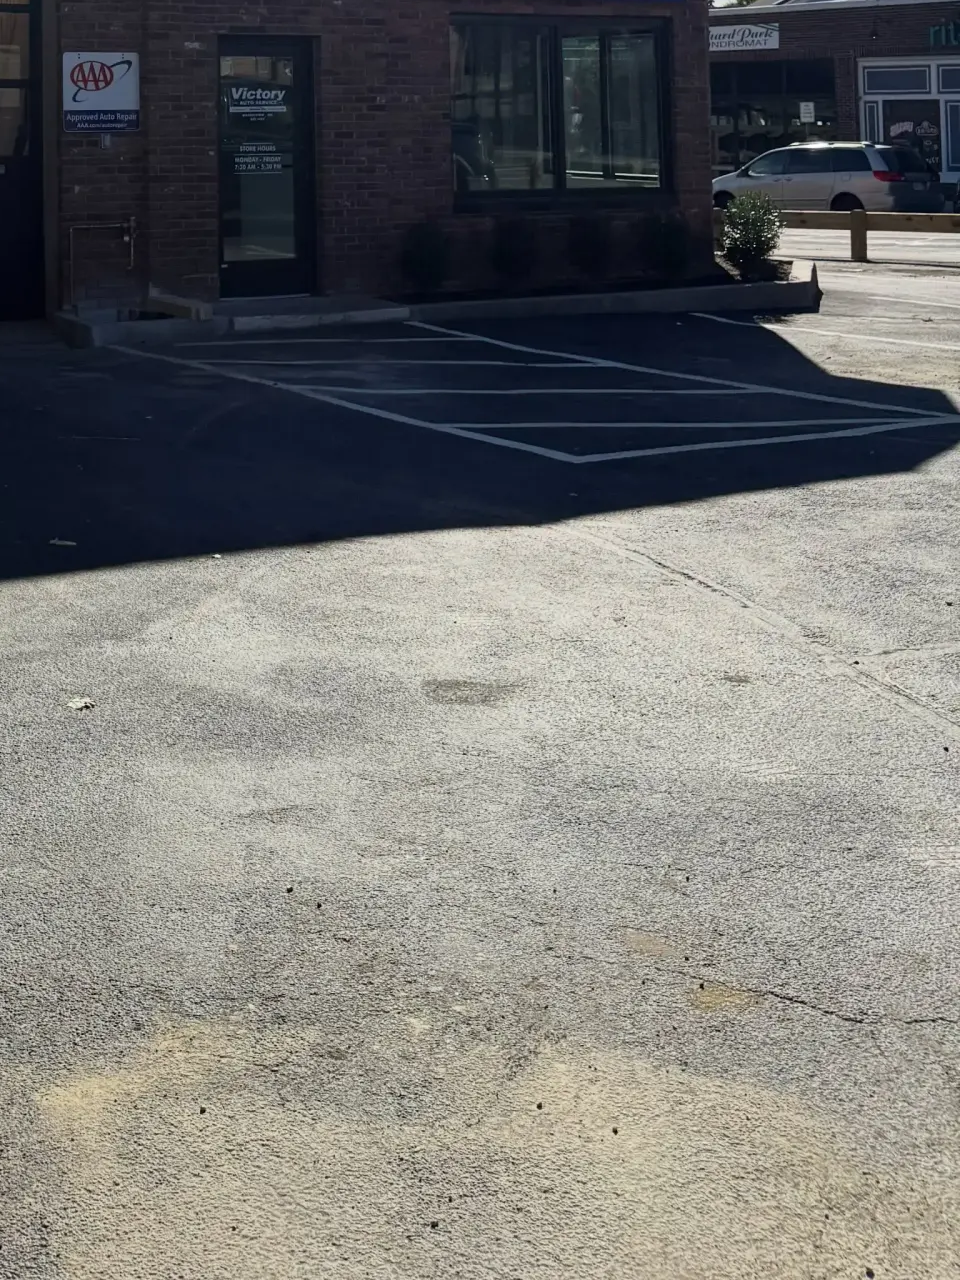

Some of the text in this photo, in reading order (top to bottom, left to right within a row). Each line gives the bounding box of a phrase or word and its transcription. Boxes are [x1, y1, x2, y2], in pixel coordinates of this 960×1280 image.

[737, 28, 774, 42] Park
[73, 61, 110, 91] AAA
[231, 87, 286, 101] Victory
[66, 113, 98, 122] Approved
[116, 113, 138, 121] Repair
